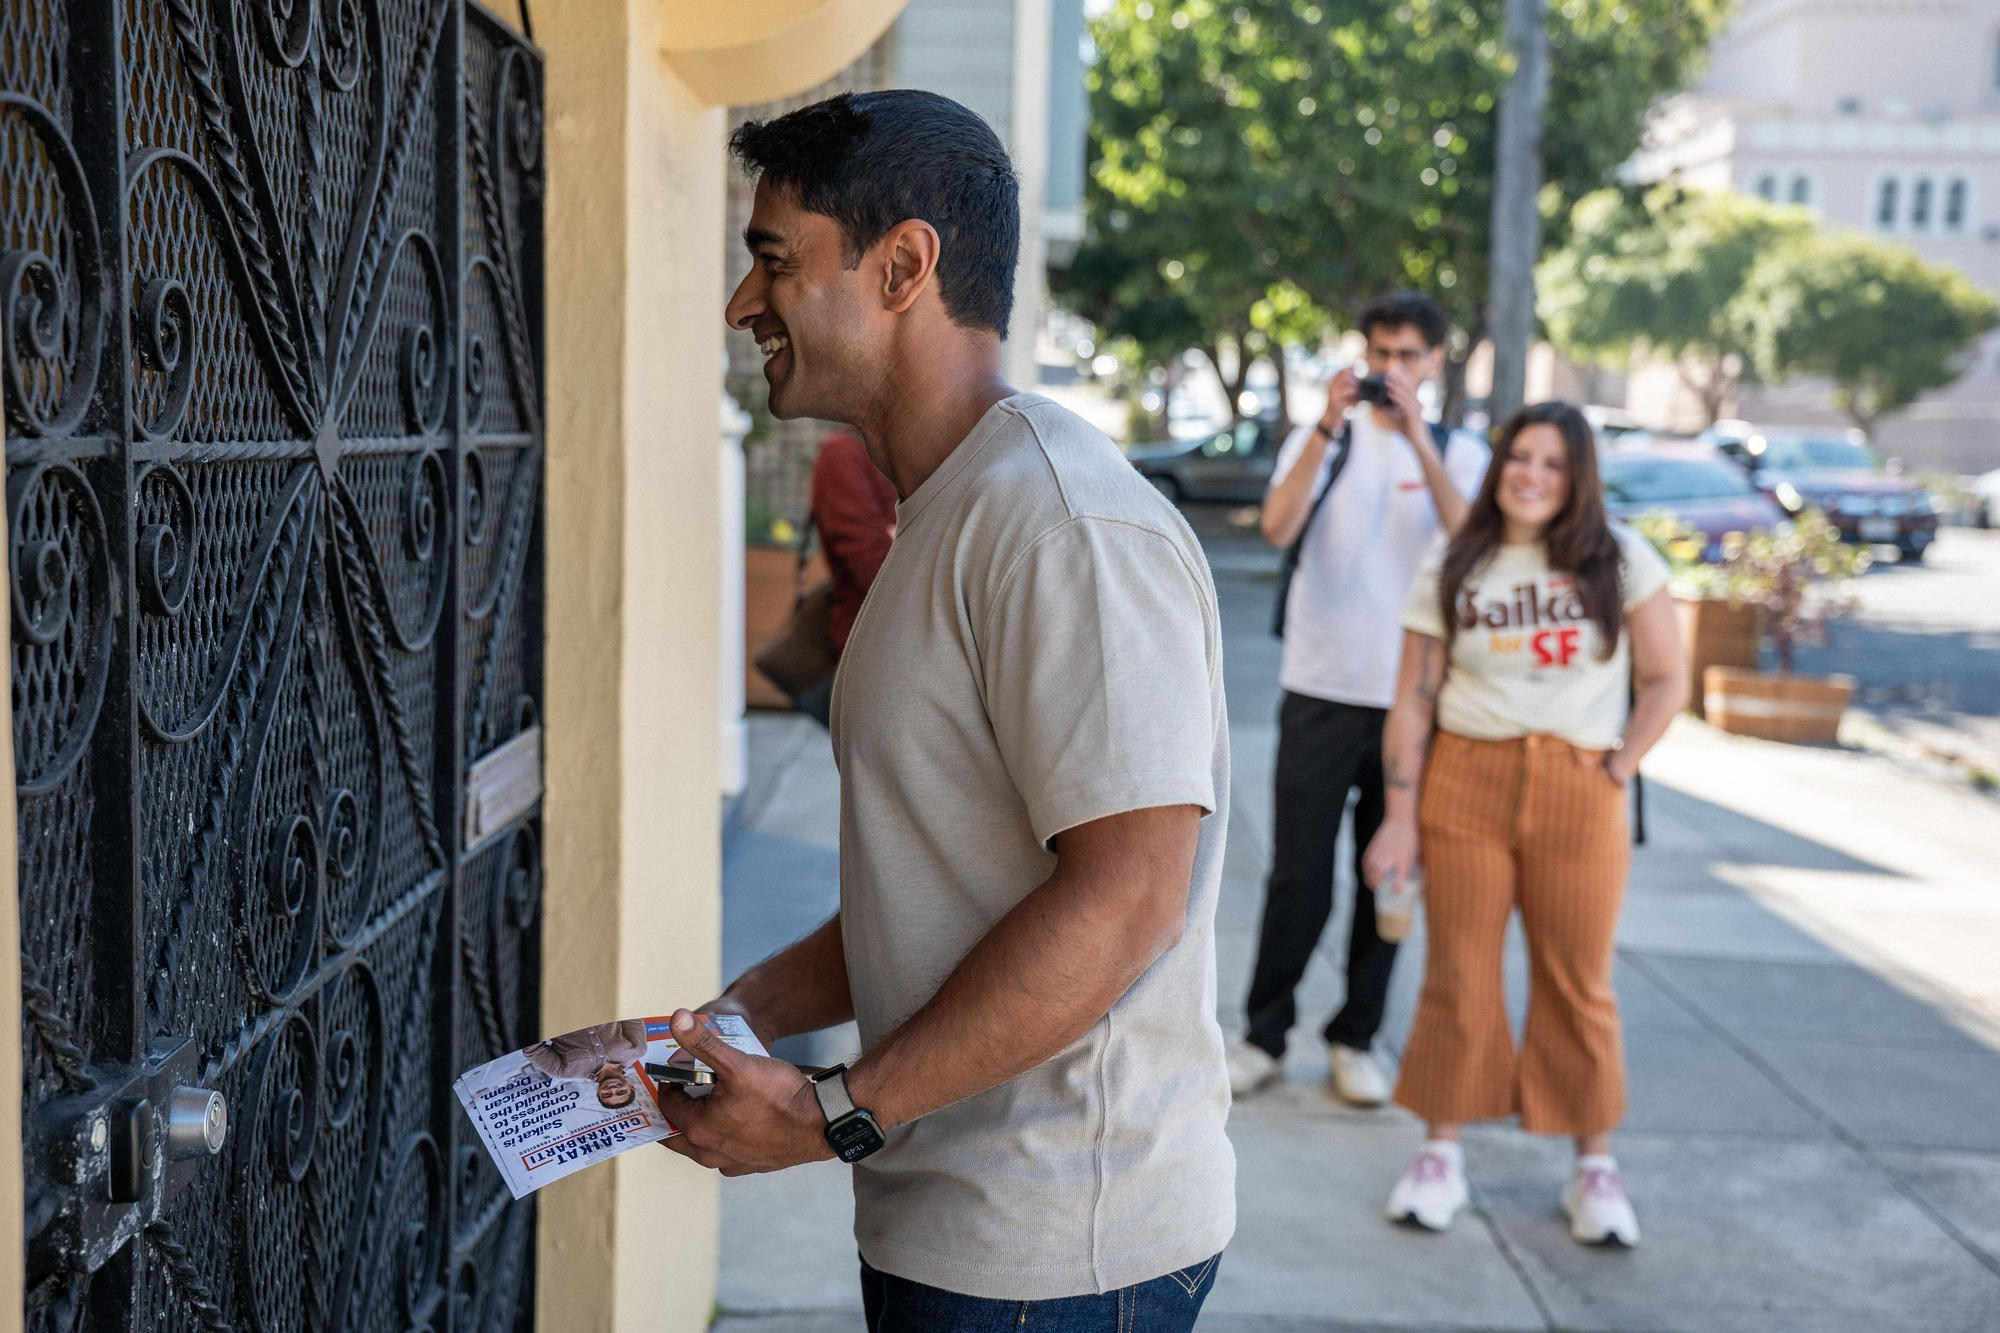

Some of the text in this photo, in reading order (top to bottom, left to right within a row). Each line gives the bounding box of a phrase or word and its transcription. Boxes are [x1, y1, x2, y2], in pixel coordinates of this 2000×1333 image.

[1531, 629, 1580, 666] SF
[480, 1077, 531, 1100] Dream.
[485, 1079, 553, 1111] American
[490, 1085, 565, 1120] rebuild the
[494, 1091, 580, 1129] Congress to
[500, 1102, 577, 1139] running for
[503, 1119, 563, 1148] Saikat is
[530, 1117, 641, 1164] CHAKRABARTI
[552, 1134, 564, 1142] SAN
[570, 1121, 600, 1134] CONGRESS
[519, 1139, 551, 1155] FRANCISCO
[557, 1132, 626, 1165] SAIKAT
